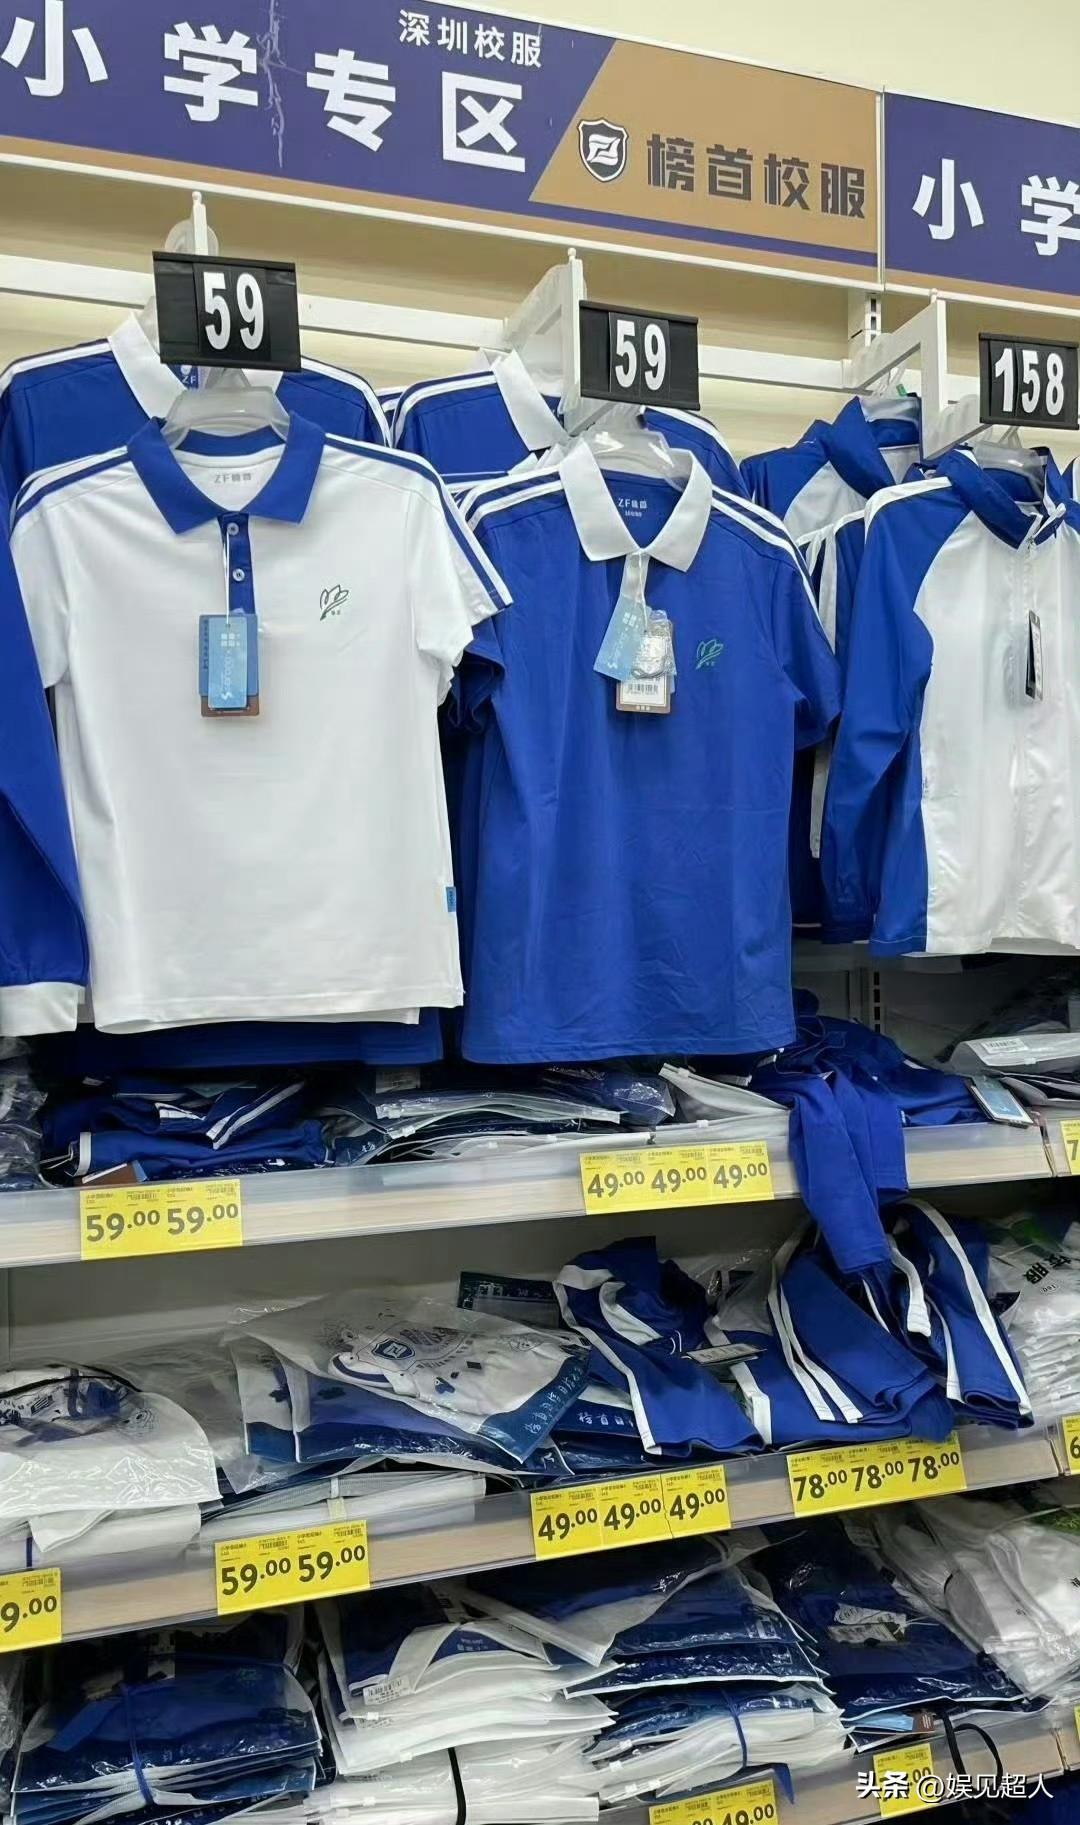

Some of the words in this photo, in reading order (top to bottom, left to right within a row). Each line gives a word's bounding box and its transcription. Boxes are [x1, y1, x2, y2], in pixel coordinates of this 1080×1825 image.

[398, 9, 542, 68] 深圳校服
[1, 0, 526, 173] 小学专区
[647, 133, 866, 219] 榜首校服
[203, 272, 265, 350] 59
[615, 319, 668, 391] 59
[995, 347, 1065, 416] 158
[587, 1171, 645, 1198] 49.00
[651, 1167, 707, 1193] 49.00
[713, 1162, 768, 1188] 49.00
[86, 1209, 161, 1242] 59.00
[167, 1203, 239, 1235] 59.00
[851, 1460, 904, 1492] 78.00
[908, 1451, 960, 1482] 78.00
[793, 1469, 848, 1501] 78.00
[603, 1498, 662, 1530] 49.00
[669, 1488, 726, 1520] 49.00
[538, 1508, 598, 1541] 49.00
[221, 1557, 292, 1596] 59.00
[298, 1545, 366, 1583] 59.00
